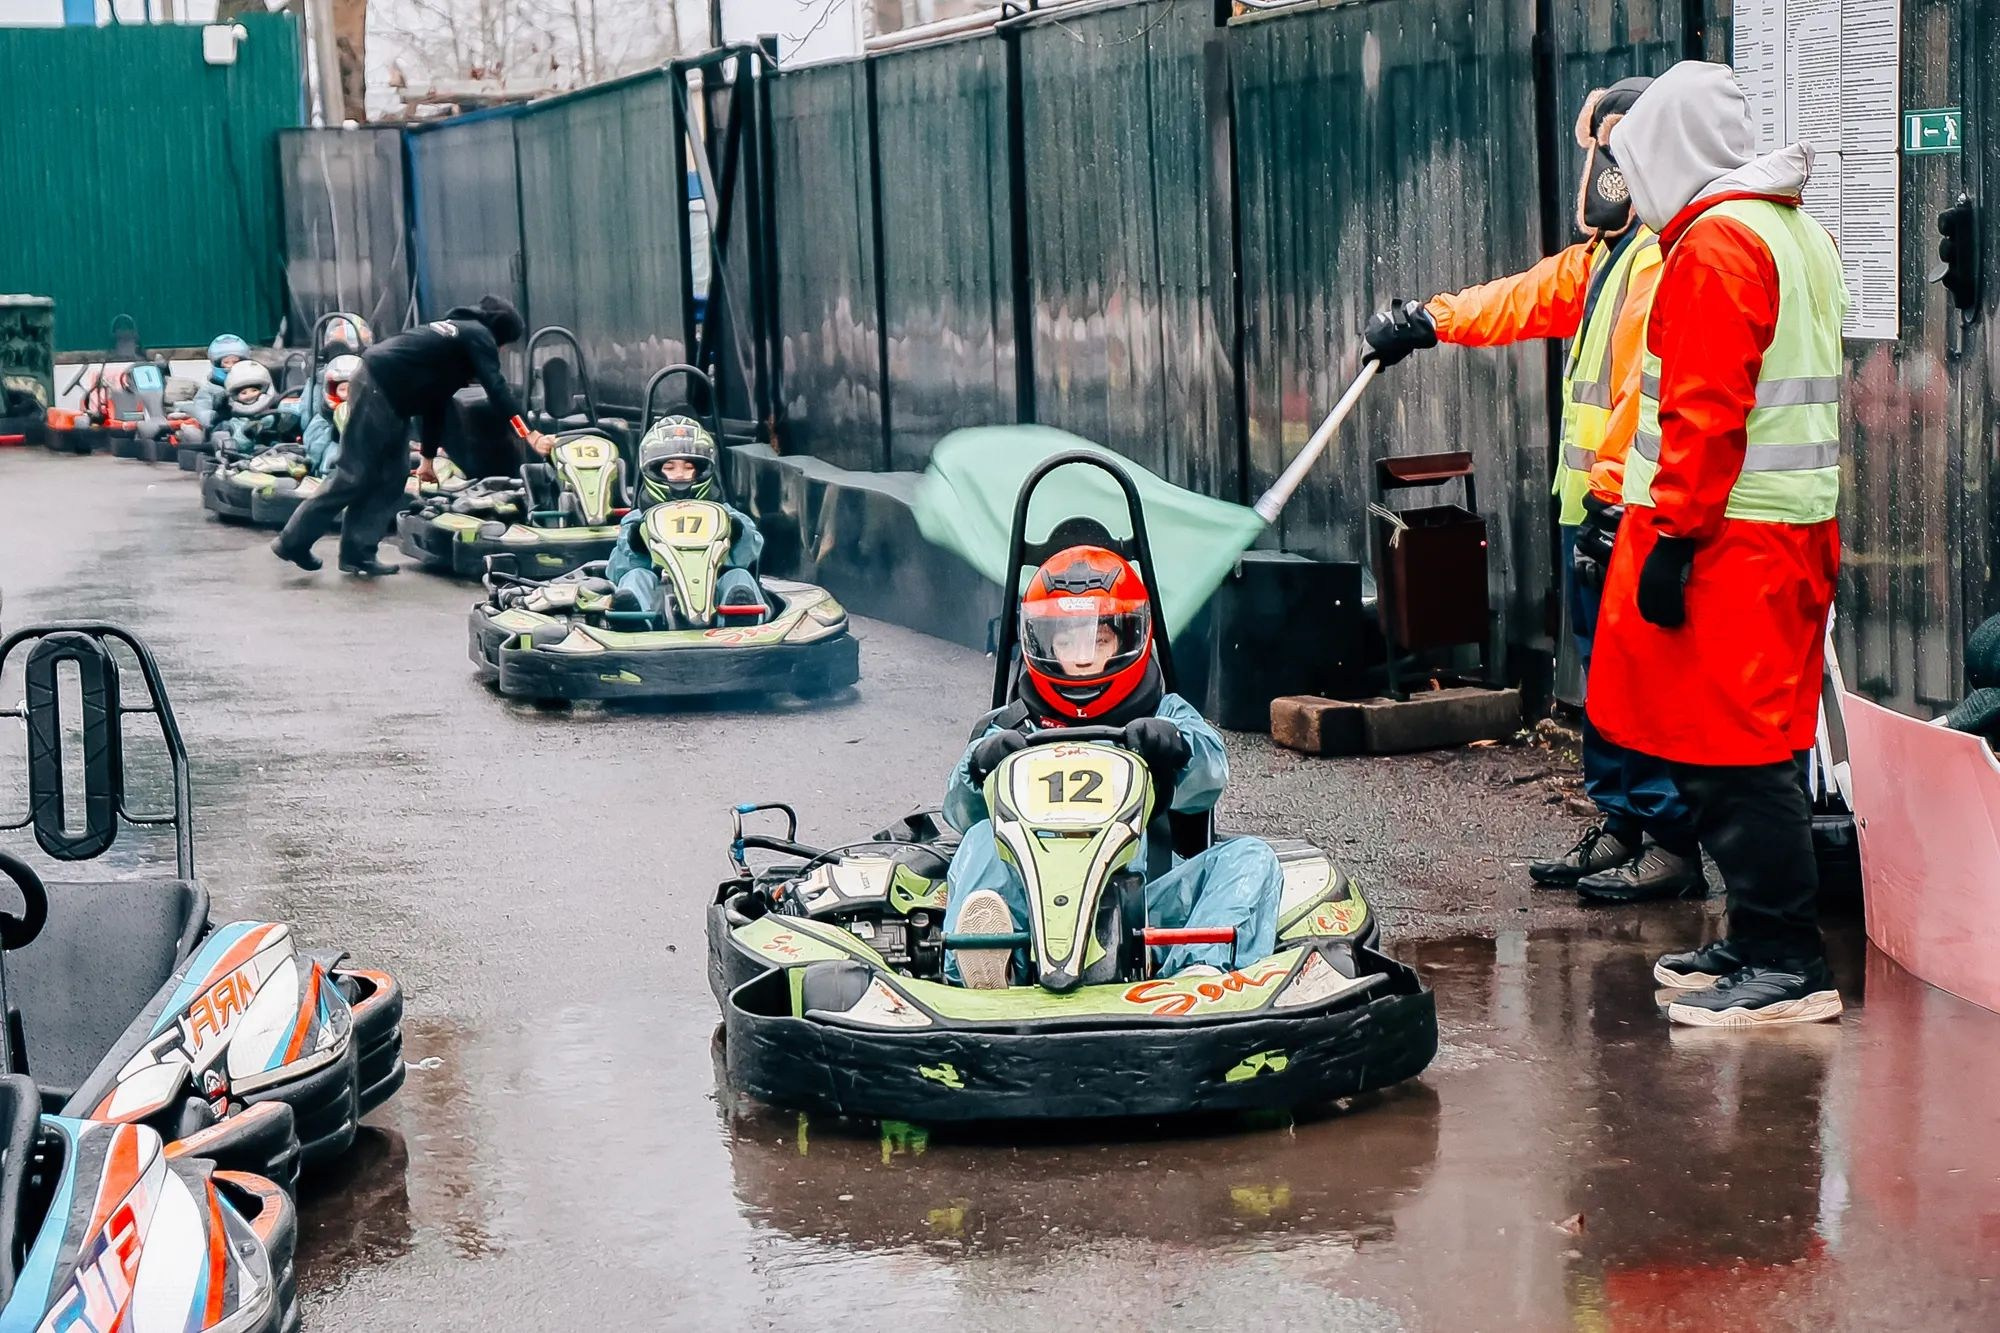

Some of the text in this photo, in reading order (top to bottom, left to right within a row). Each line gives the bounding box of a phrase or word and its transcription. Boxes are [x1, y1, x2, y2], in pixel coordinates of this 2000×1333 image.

[572, 446, 599, 458] 13
[671, 516, 703, 533] 17
[1038, 769, 1104, 804] 12
